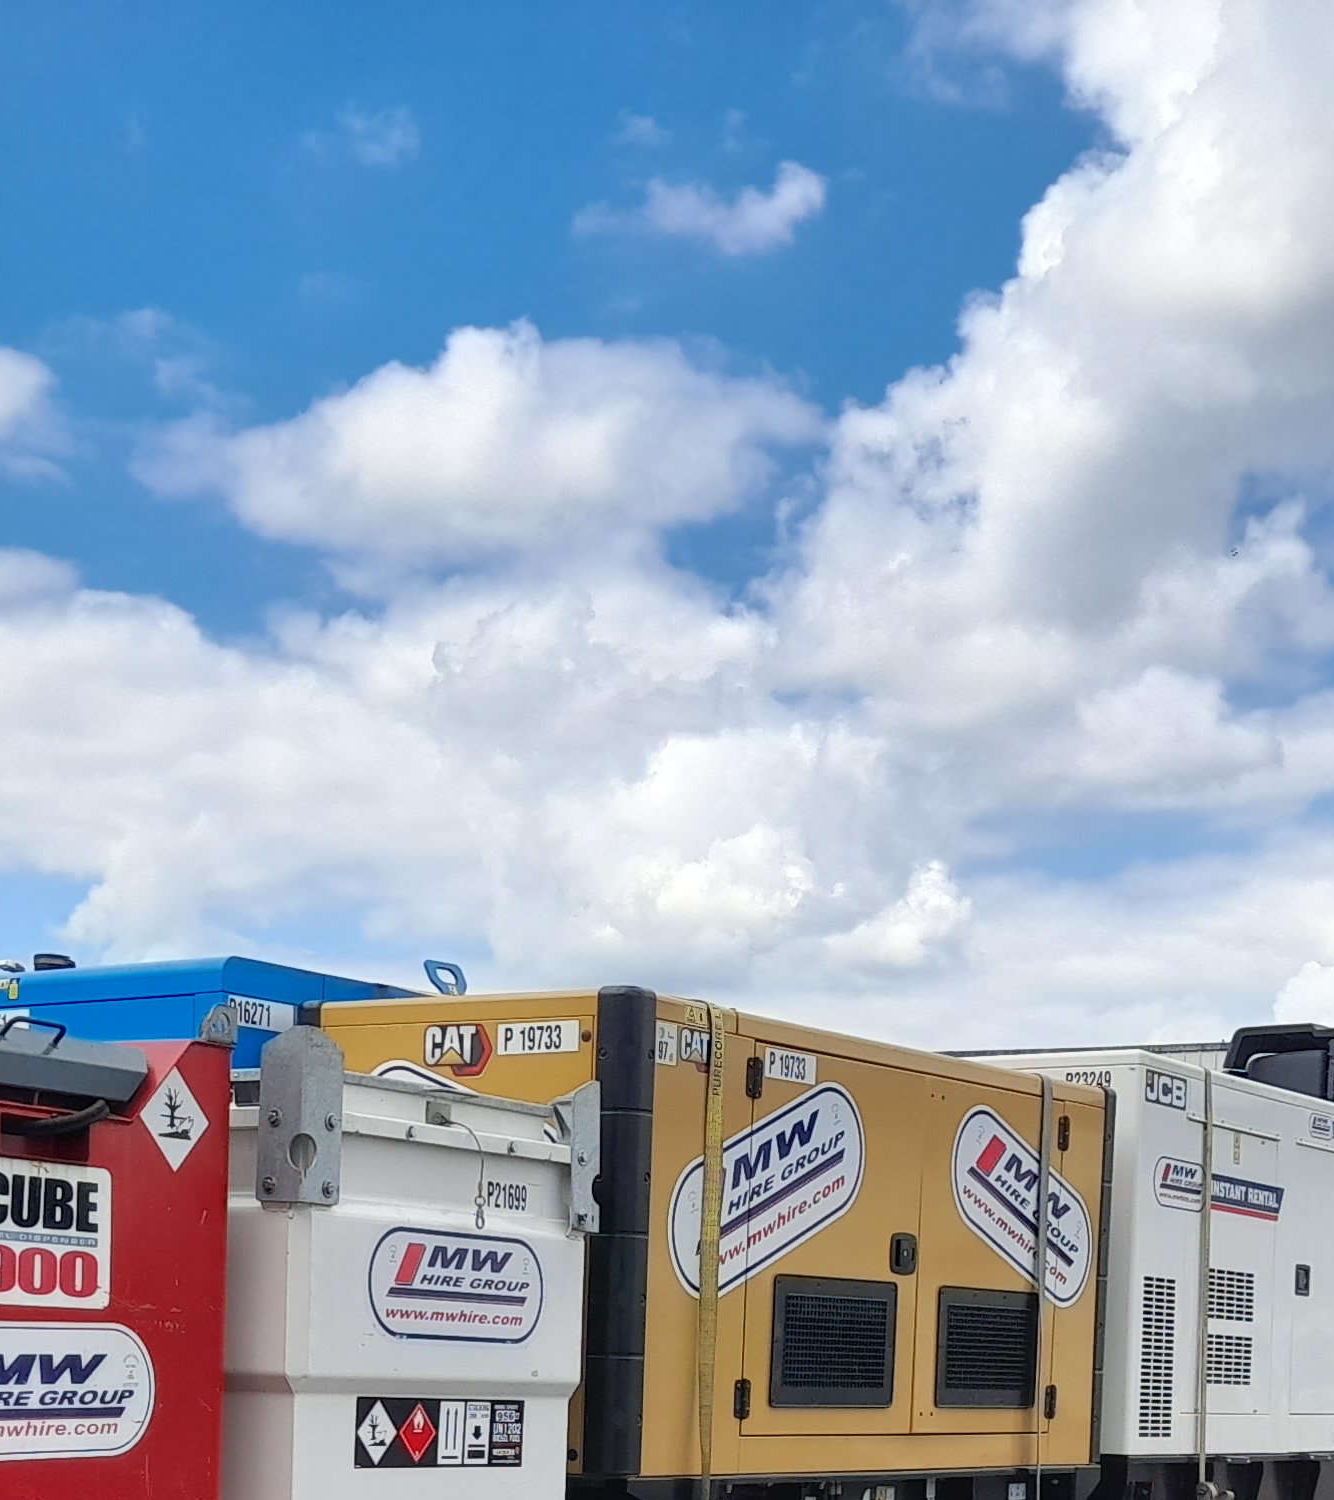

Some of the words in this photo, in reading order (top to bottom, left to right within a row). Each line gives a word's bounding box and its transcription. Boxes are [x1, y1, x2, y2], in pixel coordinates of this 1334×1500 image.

[425, 1025, 476, 1065] CAT
[504, 1027, 514, 1051] P
[520, 1025, 562, 1050] 19733
[681, 1029, 710, 1063] CAT
[769, 1051, 776, 1075] P
[779, 1054, 806, 1081] 19733
[1147, 1072, 1186, 1108] JCB
[731, 1108, 820, 1191] MW
[728, 1174, 775, 1215] HIRE
[781, 1131, 845, 1182] GROUP
[1172, 1165, 1197, 1180] MW
[487, 1181, 527, 1211] P21699
[994, 1175, 1031, 1210] HIRE
[1211, 1180, 1247, 1202] INSTANT
[1248, 1188, 1278, 1208] RENTAL
[718, 1175, 845, 1265] ww.mwhire.com
[963, 1185, 1067, 1285] www.mwhirecom
[19, 1234, 96, 1247] DISPENSER
[427, 1245, 513, 1274] MW
[420, 1274, 466, 1288] HIRE
[470, 1278, 530, 1292] GROUP
[385, 1308, 523, 1327] www.mwhire.com
[39, 1389, 135, 1406] GROUP
